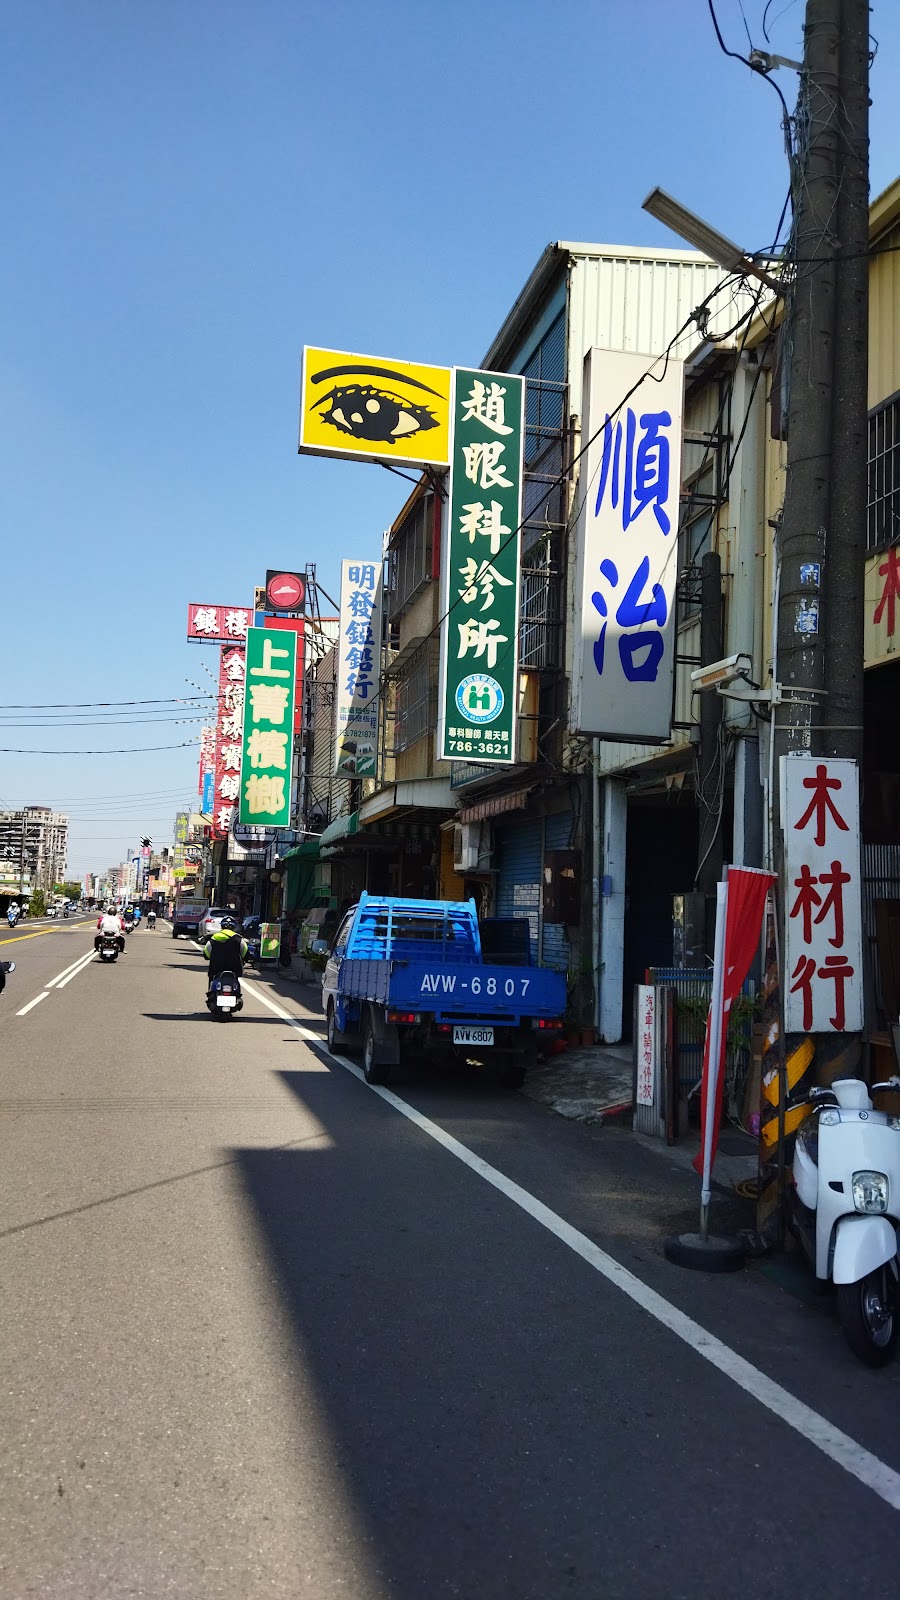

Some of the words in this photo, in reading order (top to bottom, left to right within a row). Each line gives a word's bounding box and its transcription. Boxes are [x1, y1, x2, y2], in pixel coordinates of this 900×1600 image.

[457, 379, 515, 669] 趙眼科診所
[591, 407, 672, 682] 順治
[193, 608, 248, 637] 銀樓
[246, 638, 290, 815] 上菁檳榔
[448, 727, 482, 739] 專科醫師
[448, 740, 509, 754] 786-3621
[789, 764, 854, 1031] 木材行
[420, 974, 530, 996] AVW-6807
[454, 1030, 493, 1042] AVW-6807
[643, 994, 654, 1100] 汽車請勿停放
